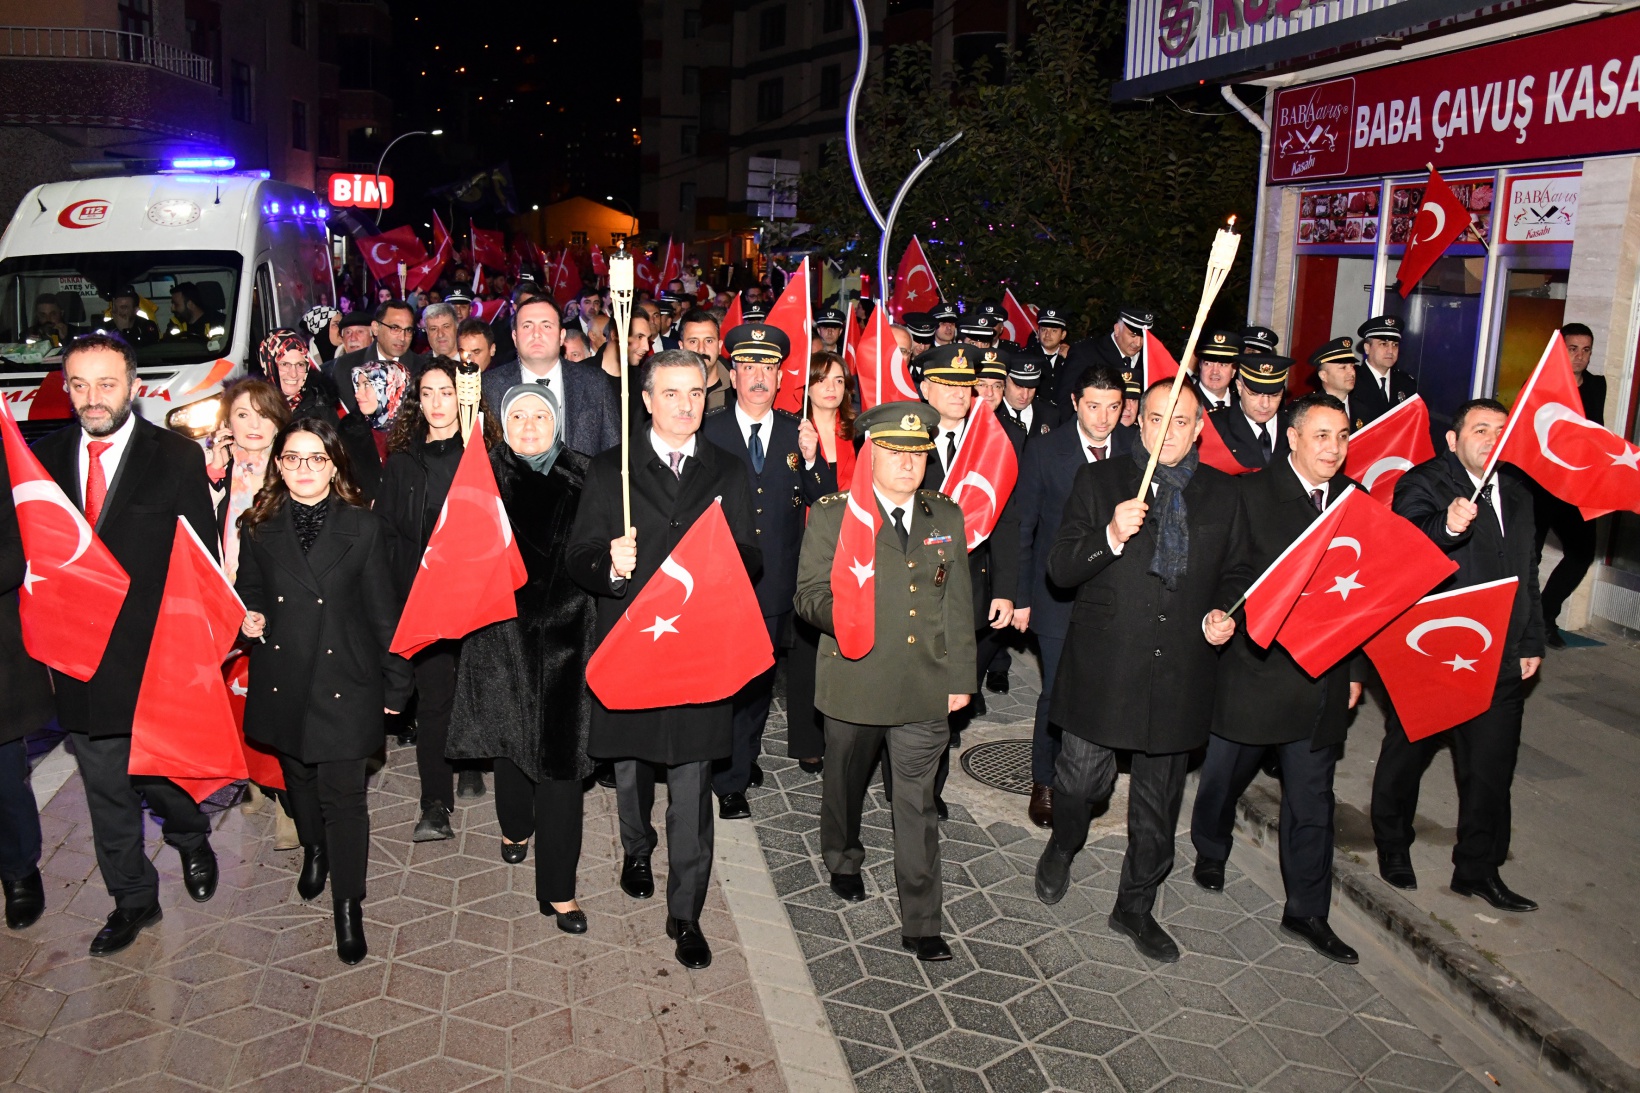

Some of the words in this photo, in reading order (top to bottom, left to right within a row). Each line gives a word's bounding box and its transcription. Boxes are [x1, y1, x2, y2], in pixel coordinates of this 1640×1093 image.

[1280, 102, 1316, 127] BABA
[1354, 96, 1422, 148] BABA
[1432, 75, 1535, 153] ÇAVUŞ
[1544, 56, 1640, 125] KASA
[333, 174, 388, 203] BİM
[1513, 190, 1550, 204] BABA
[85, 206, 103, 214] 112
